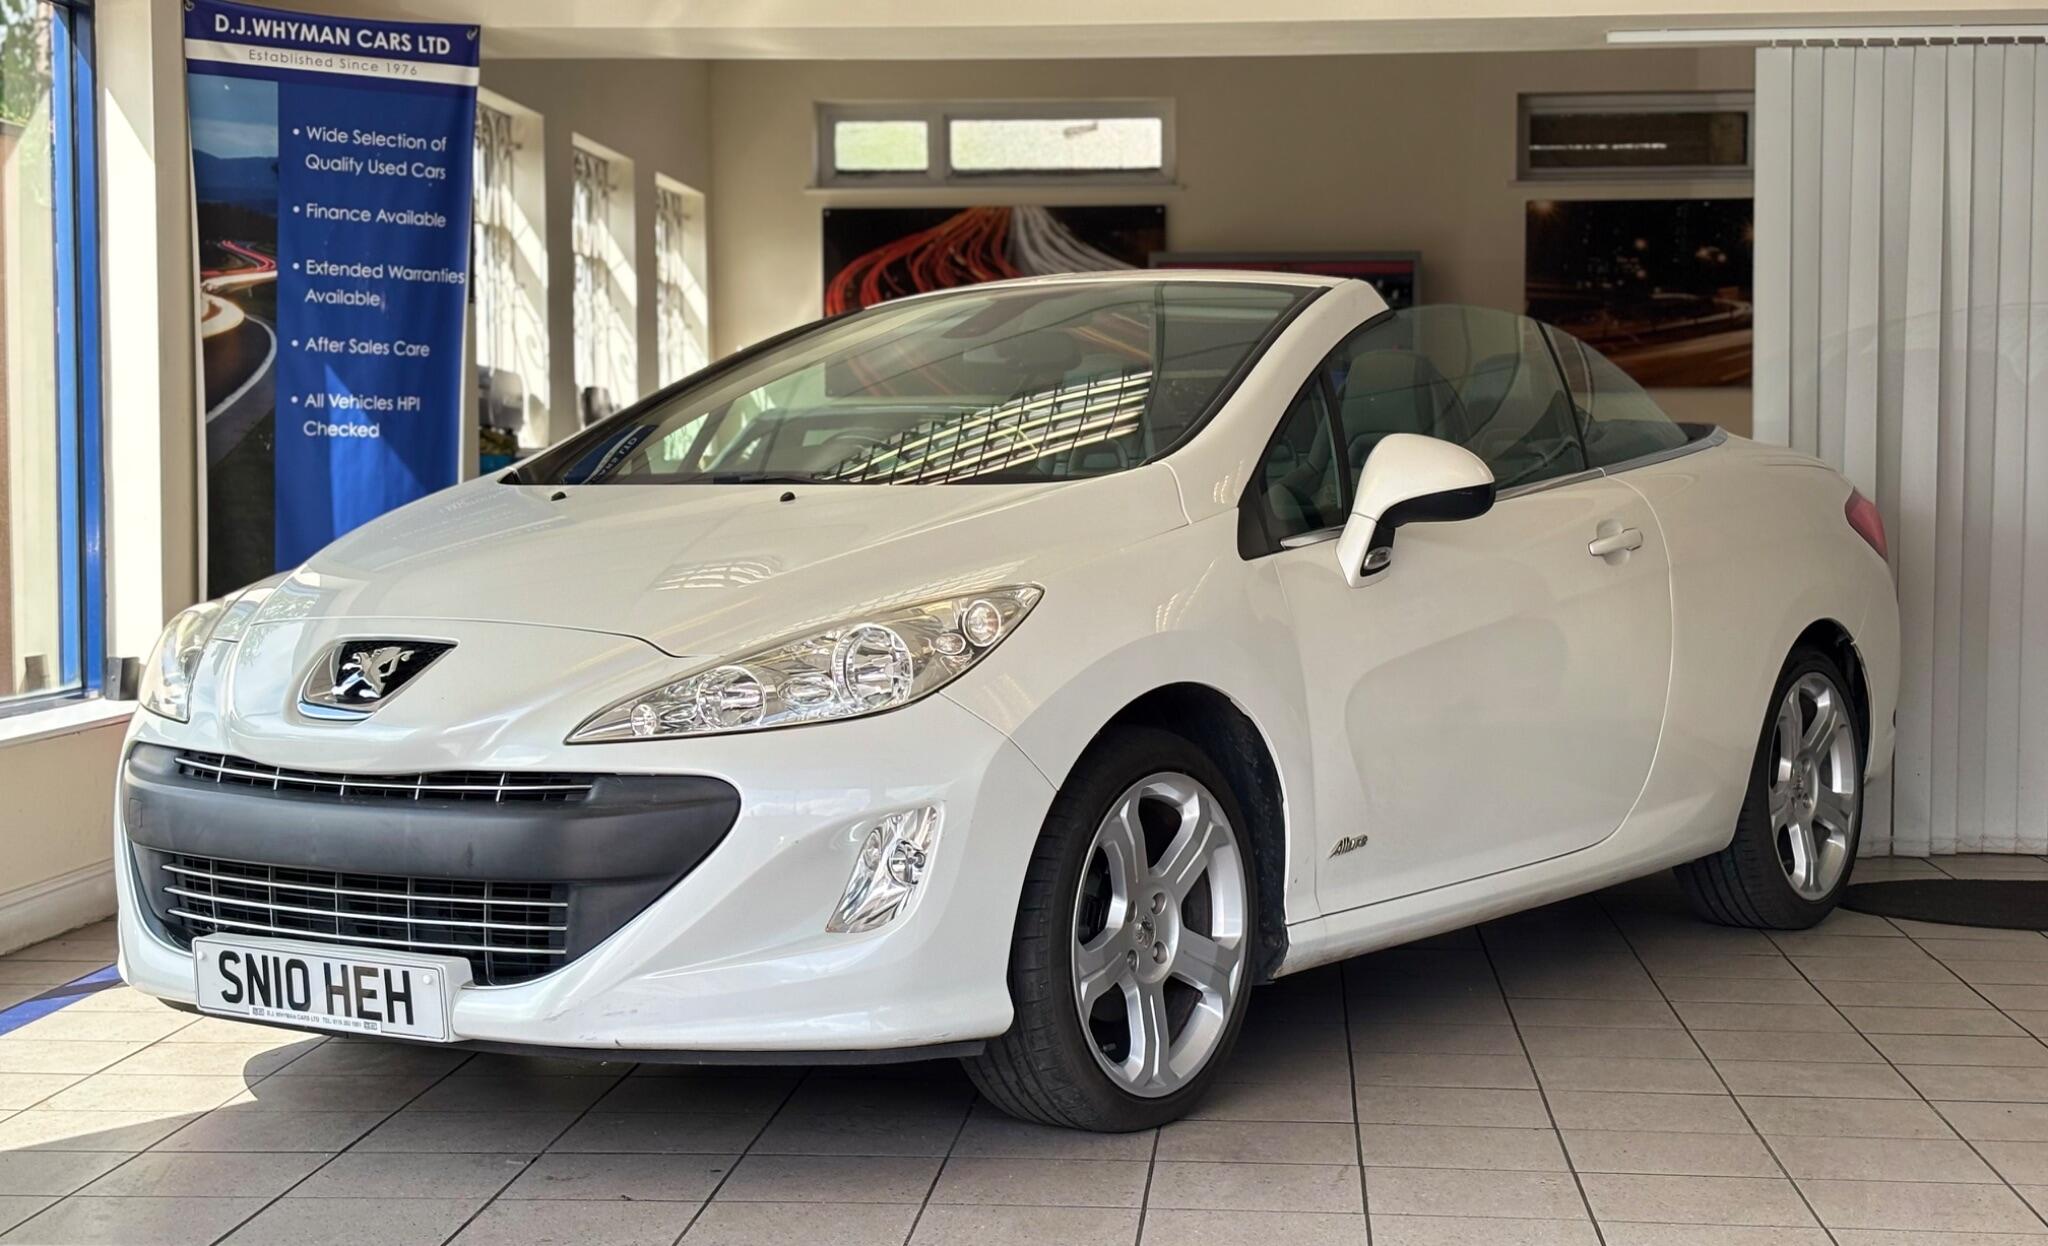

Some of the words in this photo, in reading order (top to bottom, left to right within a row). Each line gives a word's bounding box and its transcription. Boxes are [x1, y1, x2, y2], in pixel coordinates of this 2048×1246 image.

[214, 14, 350, 46] D.J.WHYMAN
[357, 29, 411, 52] CARS
[418, 36, 450, 55] LTD
[249, 49, 333, 69] Established
[339, 58, 379, 73] Since
[385, 62, 418, 76] 1976
[306, 126, 348, 144] Wide
[352, 129, 426, 150] Selection
[430, 136, 447, 151] of
[305, 154, 364, 177] Quality
[368, 159, 406, 177] Used
[411, 163, 446, 180] Cars
[306, 203, 371, 222] Finance
[375, 208, 446, 228] Available
[306, 259, 383, 279] Extended
[388, 265, 465, 284] Warranties
[305, 288, 380, 307] Available
[305, 337, 344, 353] After
[349, 338, 389, 355] Sales
[393, 341, 430, 357] Care
[304, 394, 324, 409] All
[328, 394, 393, 411] Vehicles
[397, 396, 420, 411] HPI
[303, 421, 380, 438] Checked
[218, 950, 312, 1011] SN10
[323, 962, 414, 1025] HEH
